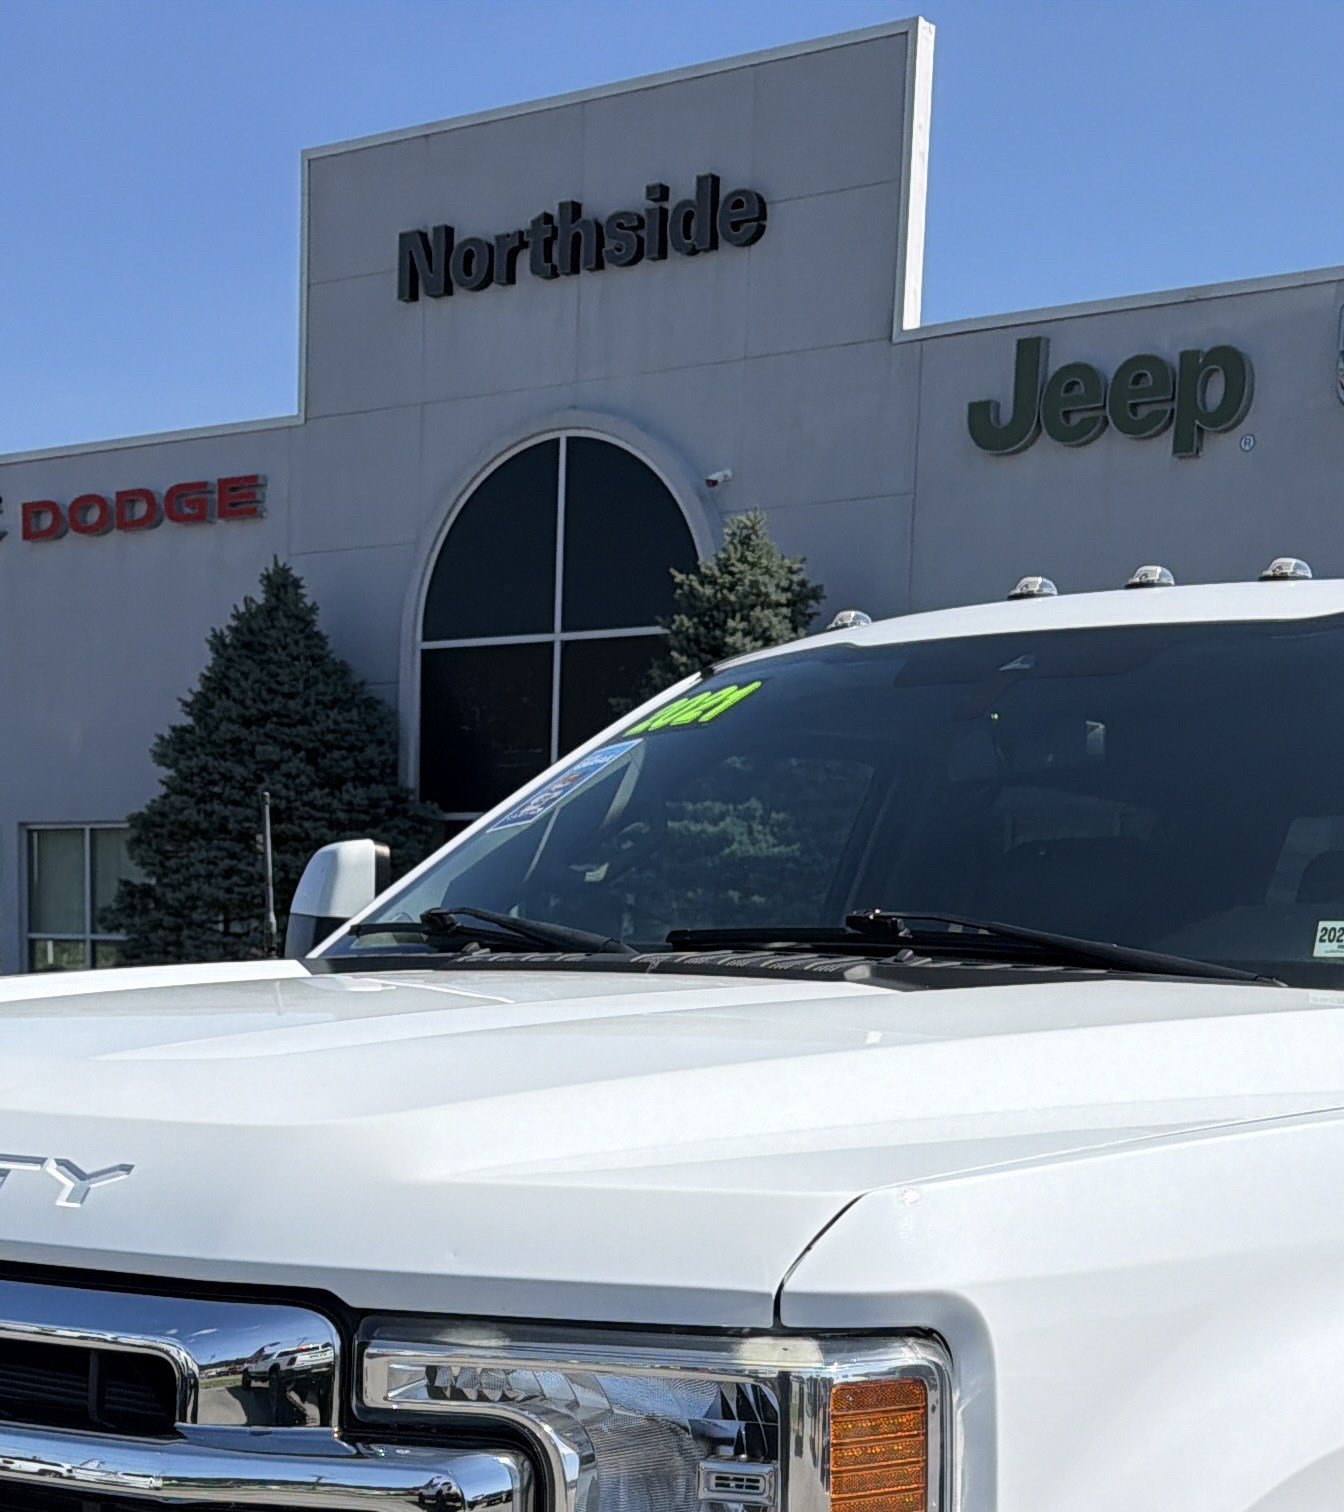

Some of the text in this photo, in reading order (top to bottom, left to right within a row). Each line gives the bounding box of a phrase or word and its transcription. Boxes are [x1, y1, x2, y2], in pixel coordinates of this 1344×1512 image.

[398, 173, 767, 302] Northside
[968, 335, 1254, 458] Jeep
[21, 474, 266, 542] DODGE
